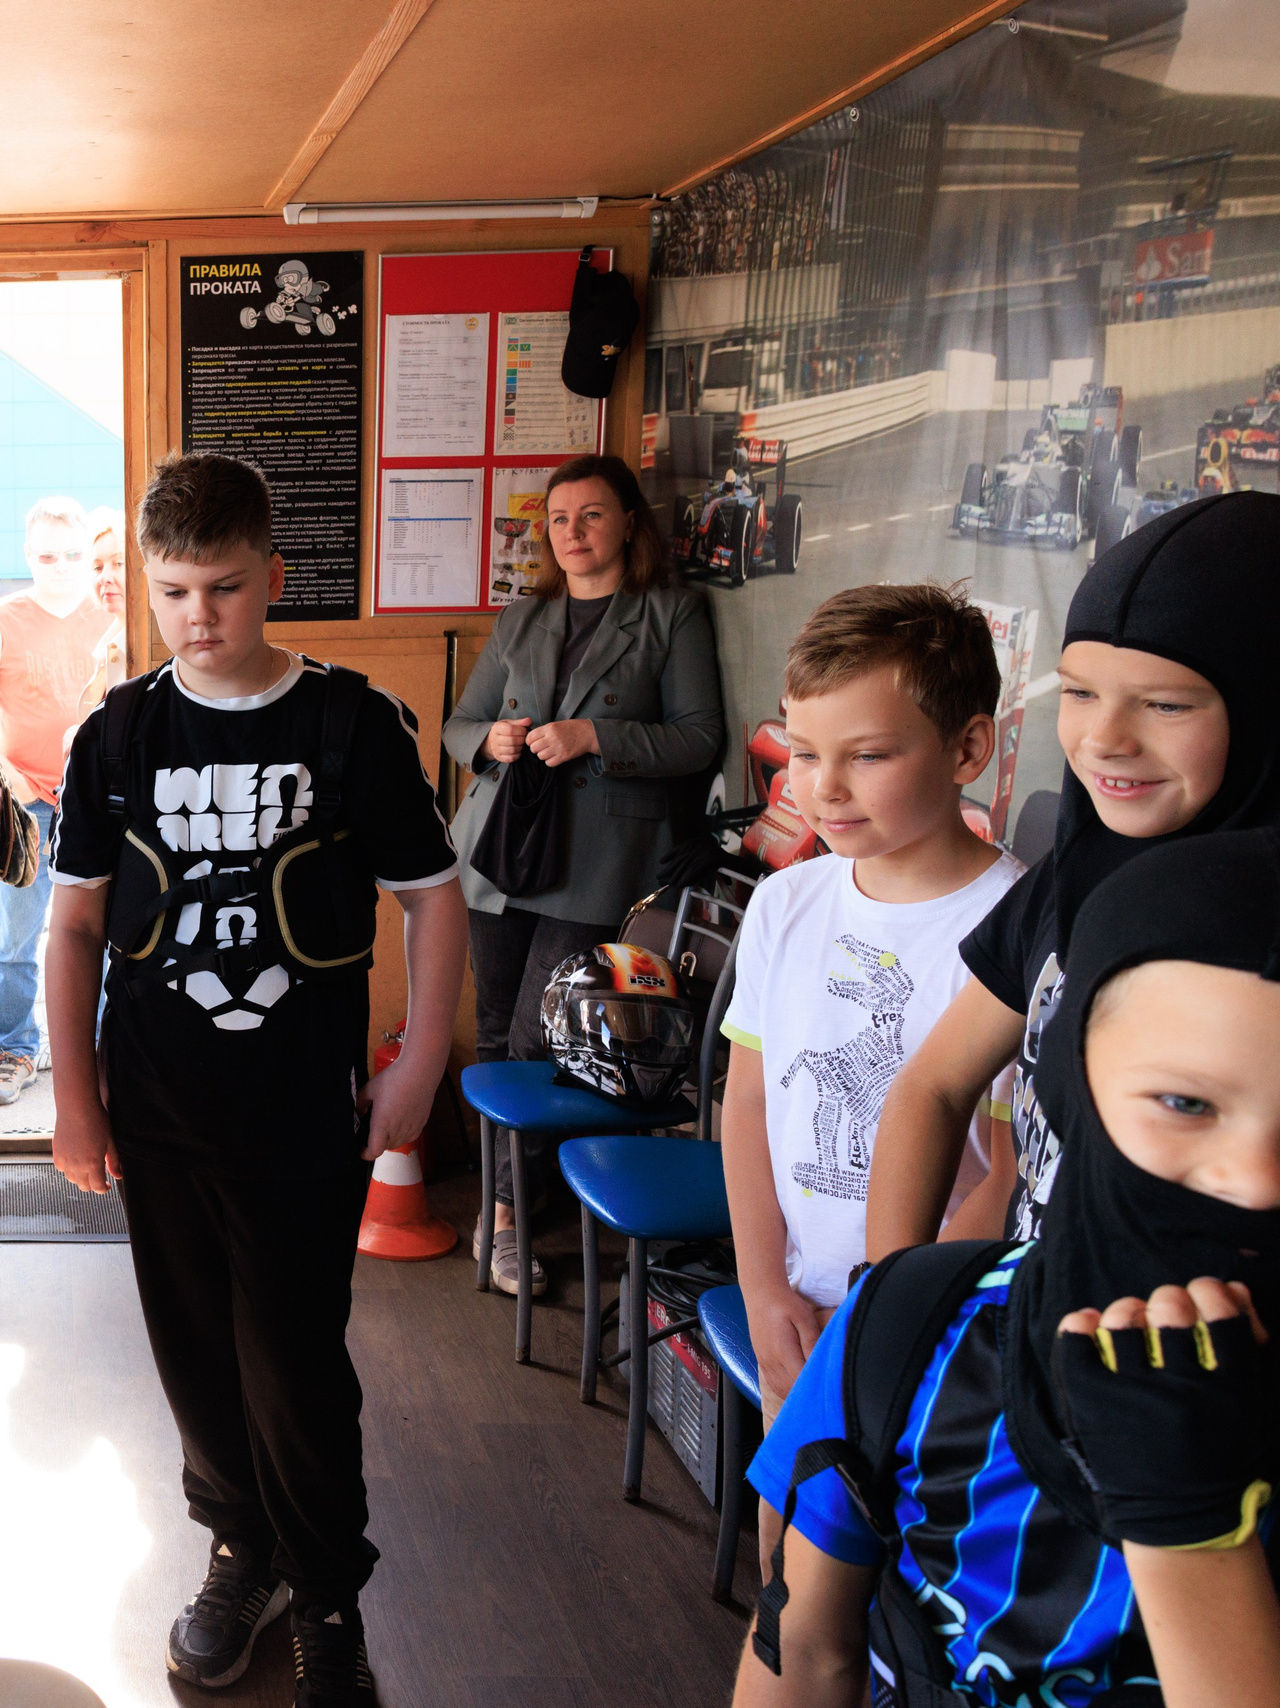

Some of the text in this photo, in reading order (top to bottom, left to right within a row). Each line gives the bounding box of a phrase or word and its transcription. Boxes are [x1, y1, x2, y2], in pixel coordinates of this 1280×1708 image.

[190, 264, 262, 278] ПРАВИЛА
[190, 280, 262, 296] ПРОКАТА
[154, 764, 259, 814] WE
[156, 812, 258, 852] ARE
[839, 993, 858, 1002] NEW
[872, 1013, 902, 1028] t-rex
[701, 1362, 711, 1379] 195
